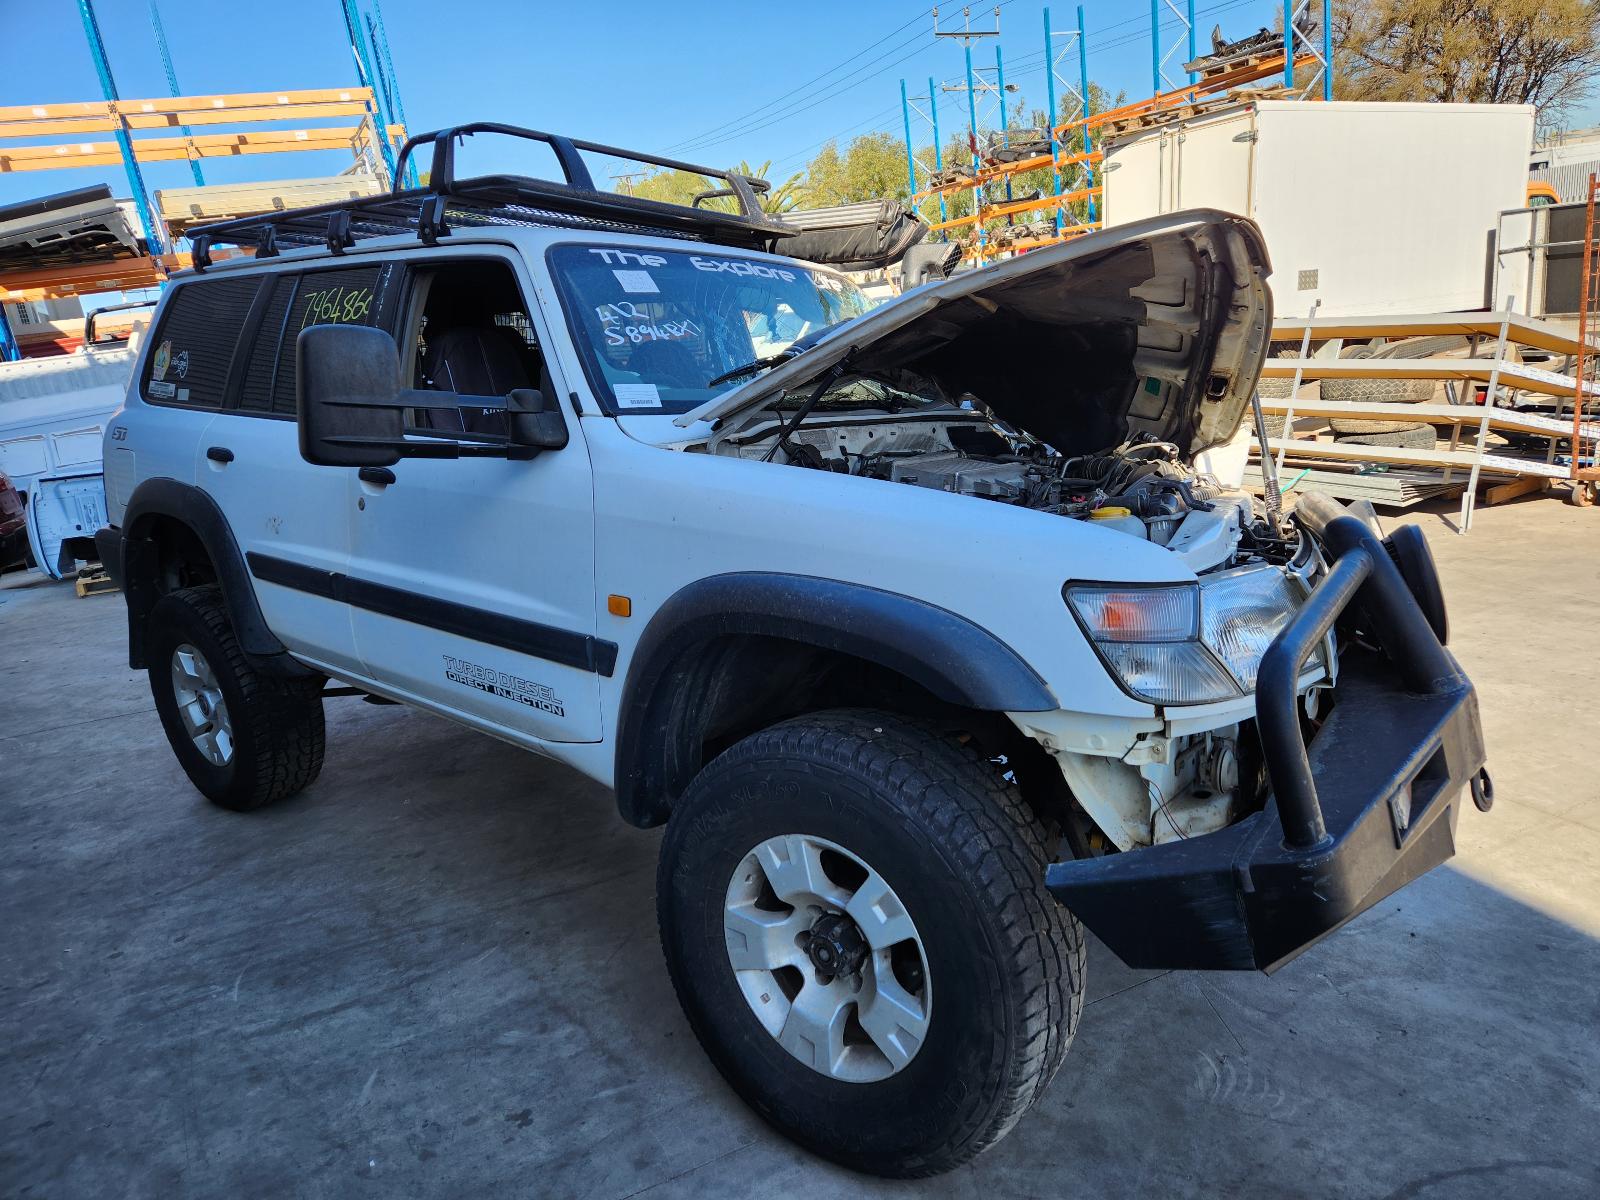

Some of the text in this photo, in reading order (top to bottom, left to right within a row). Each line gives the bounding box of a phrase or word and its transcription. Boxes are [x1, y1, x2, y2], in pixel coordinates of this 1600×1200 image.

[589, 248, 667, 267] The
[690, 256, 796, 283] Explore
[443, 655, 563, 705] TURBO DIESEL
[447, 671, 564, 716] DIRECT INJECTION
